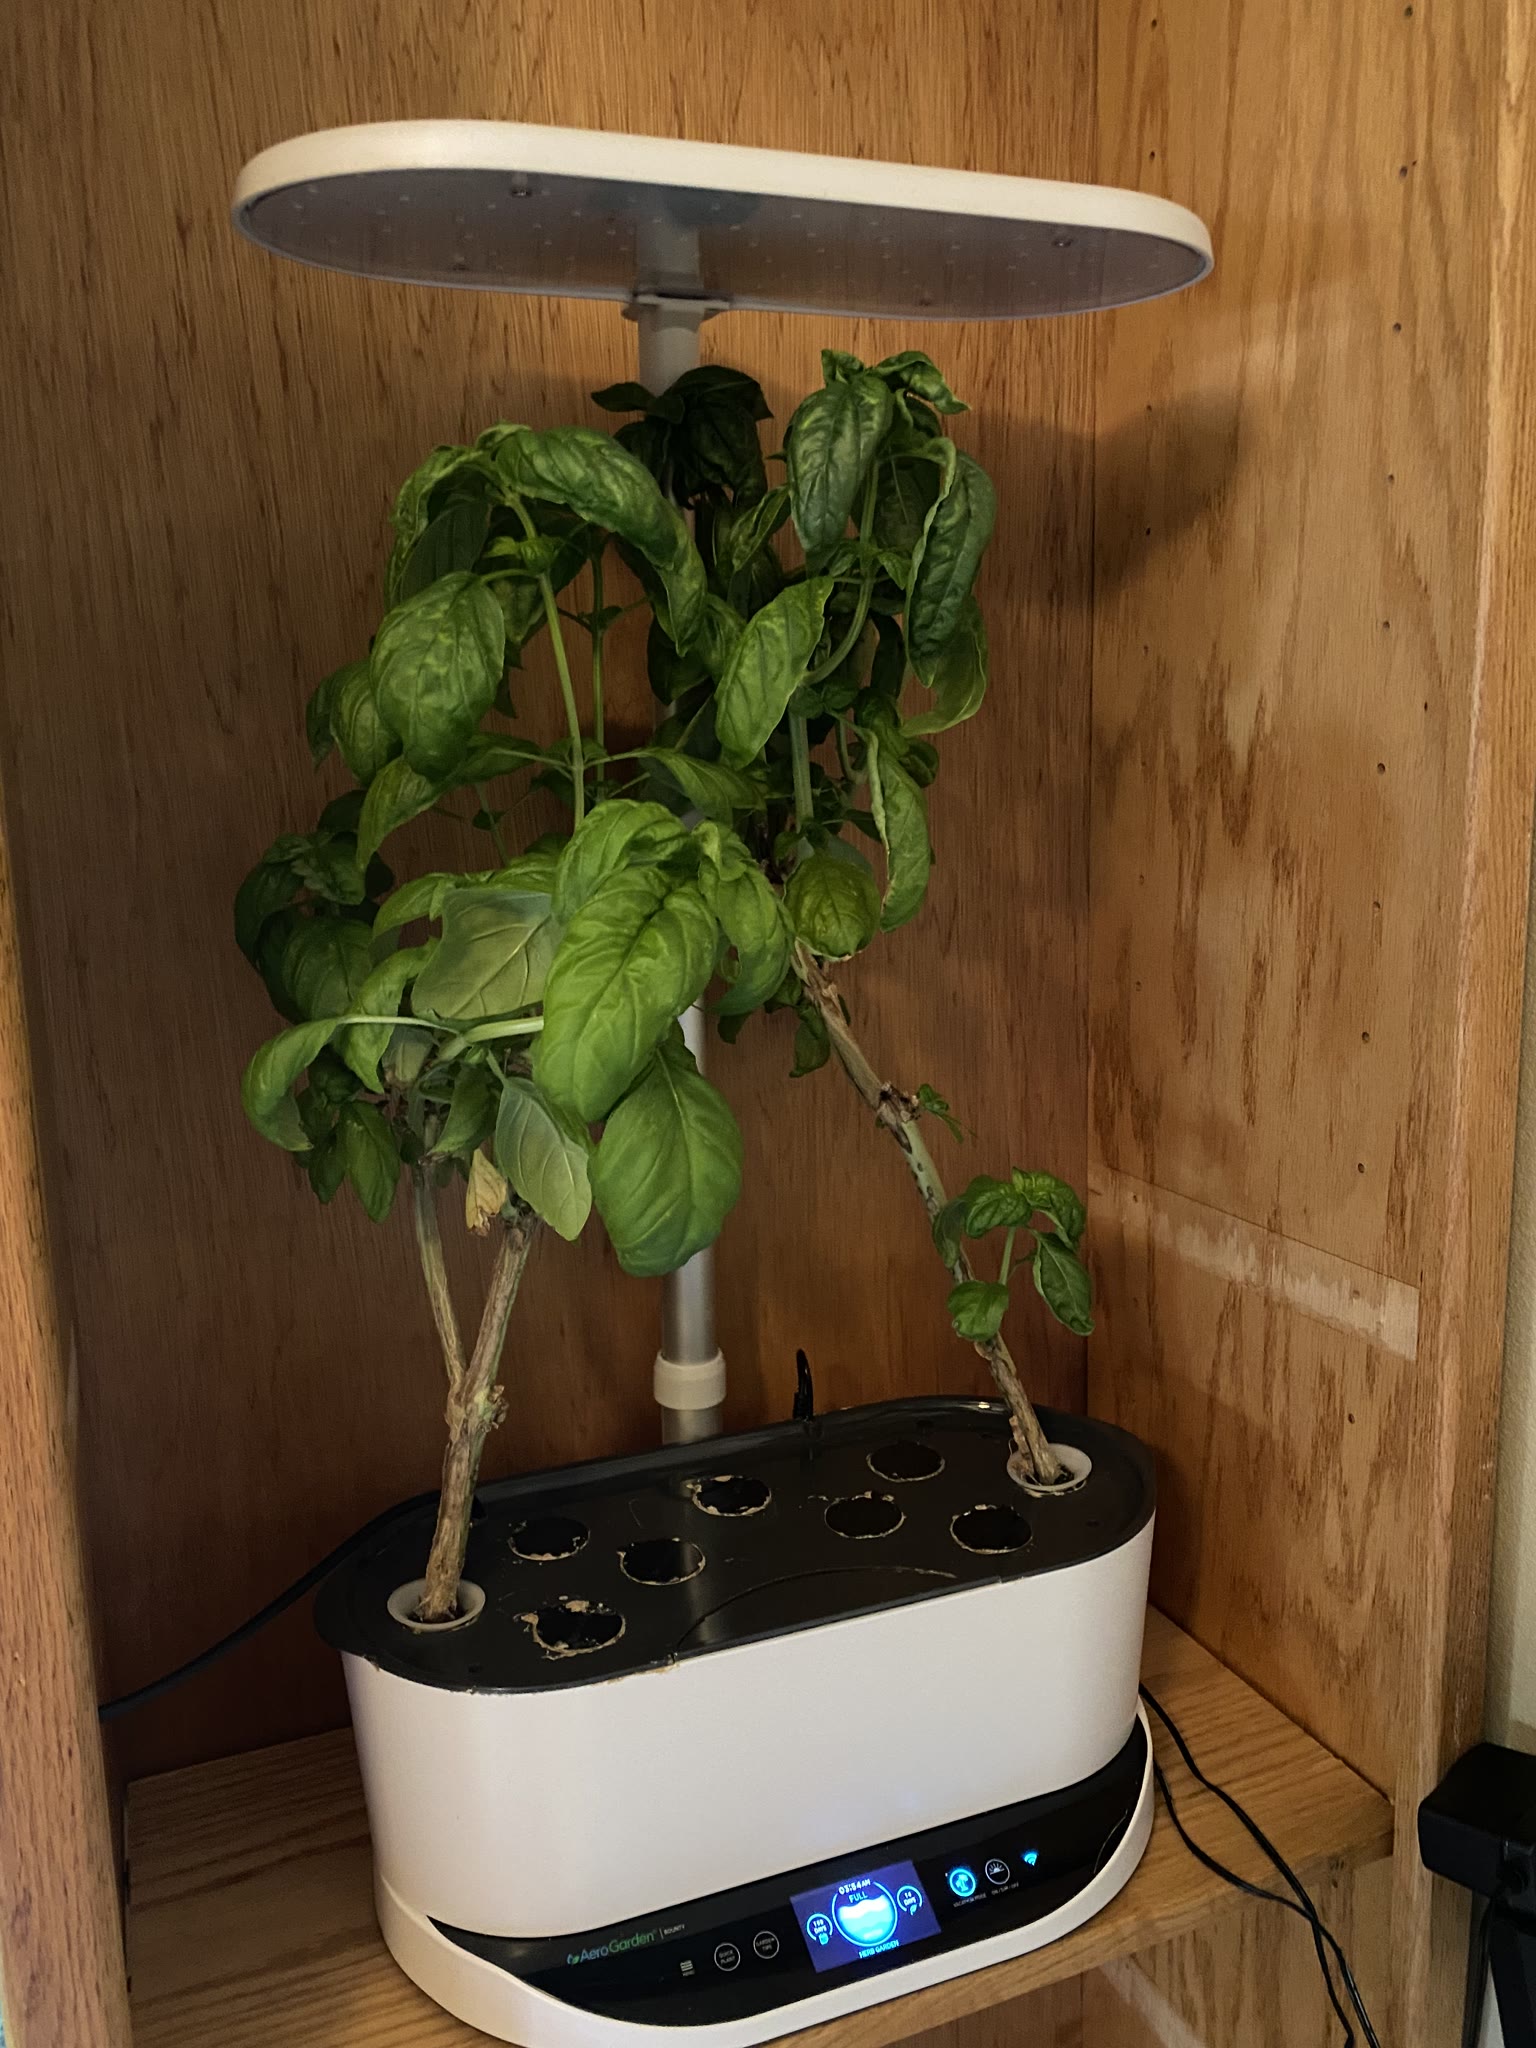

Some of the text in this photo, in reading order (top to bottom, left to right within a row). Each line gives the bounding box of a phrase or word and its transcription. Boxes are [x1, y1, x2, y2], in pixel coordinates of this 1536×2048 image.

[848, 1891, 868, 1903] FULL
[580, 1932, 656, 1963] AeroGarden
[858, 1939, 899, 1959] HERB GARDEN
